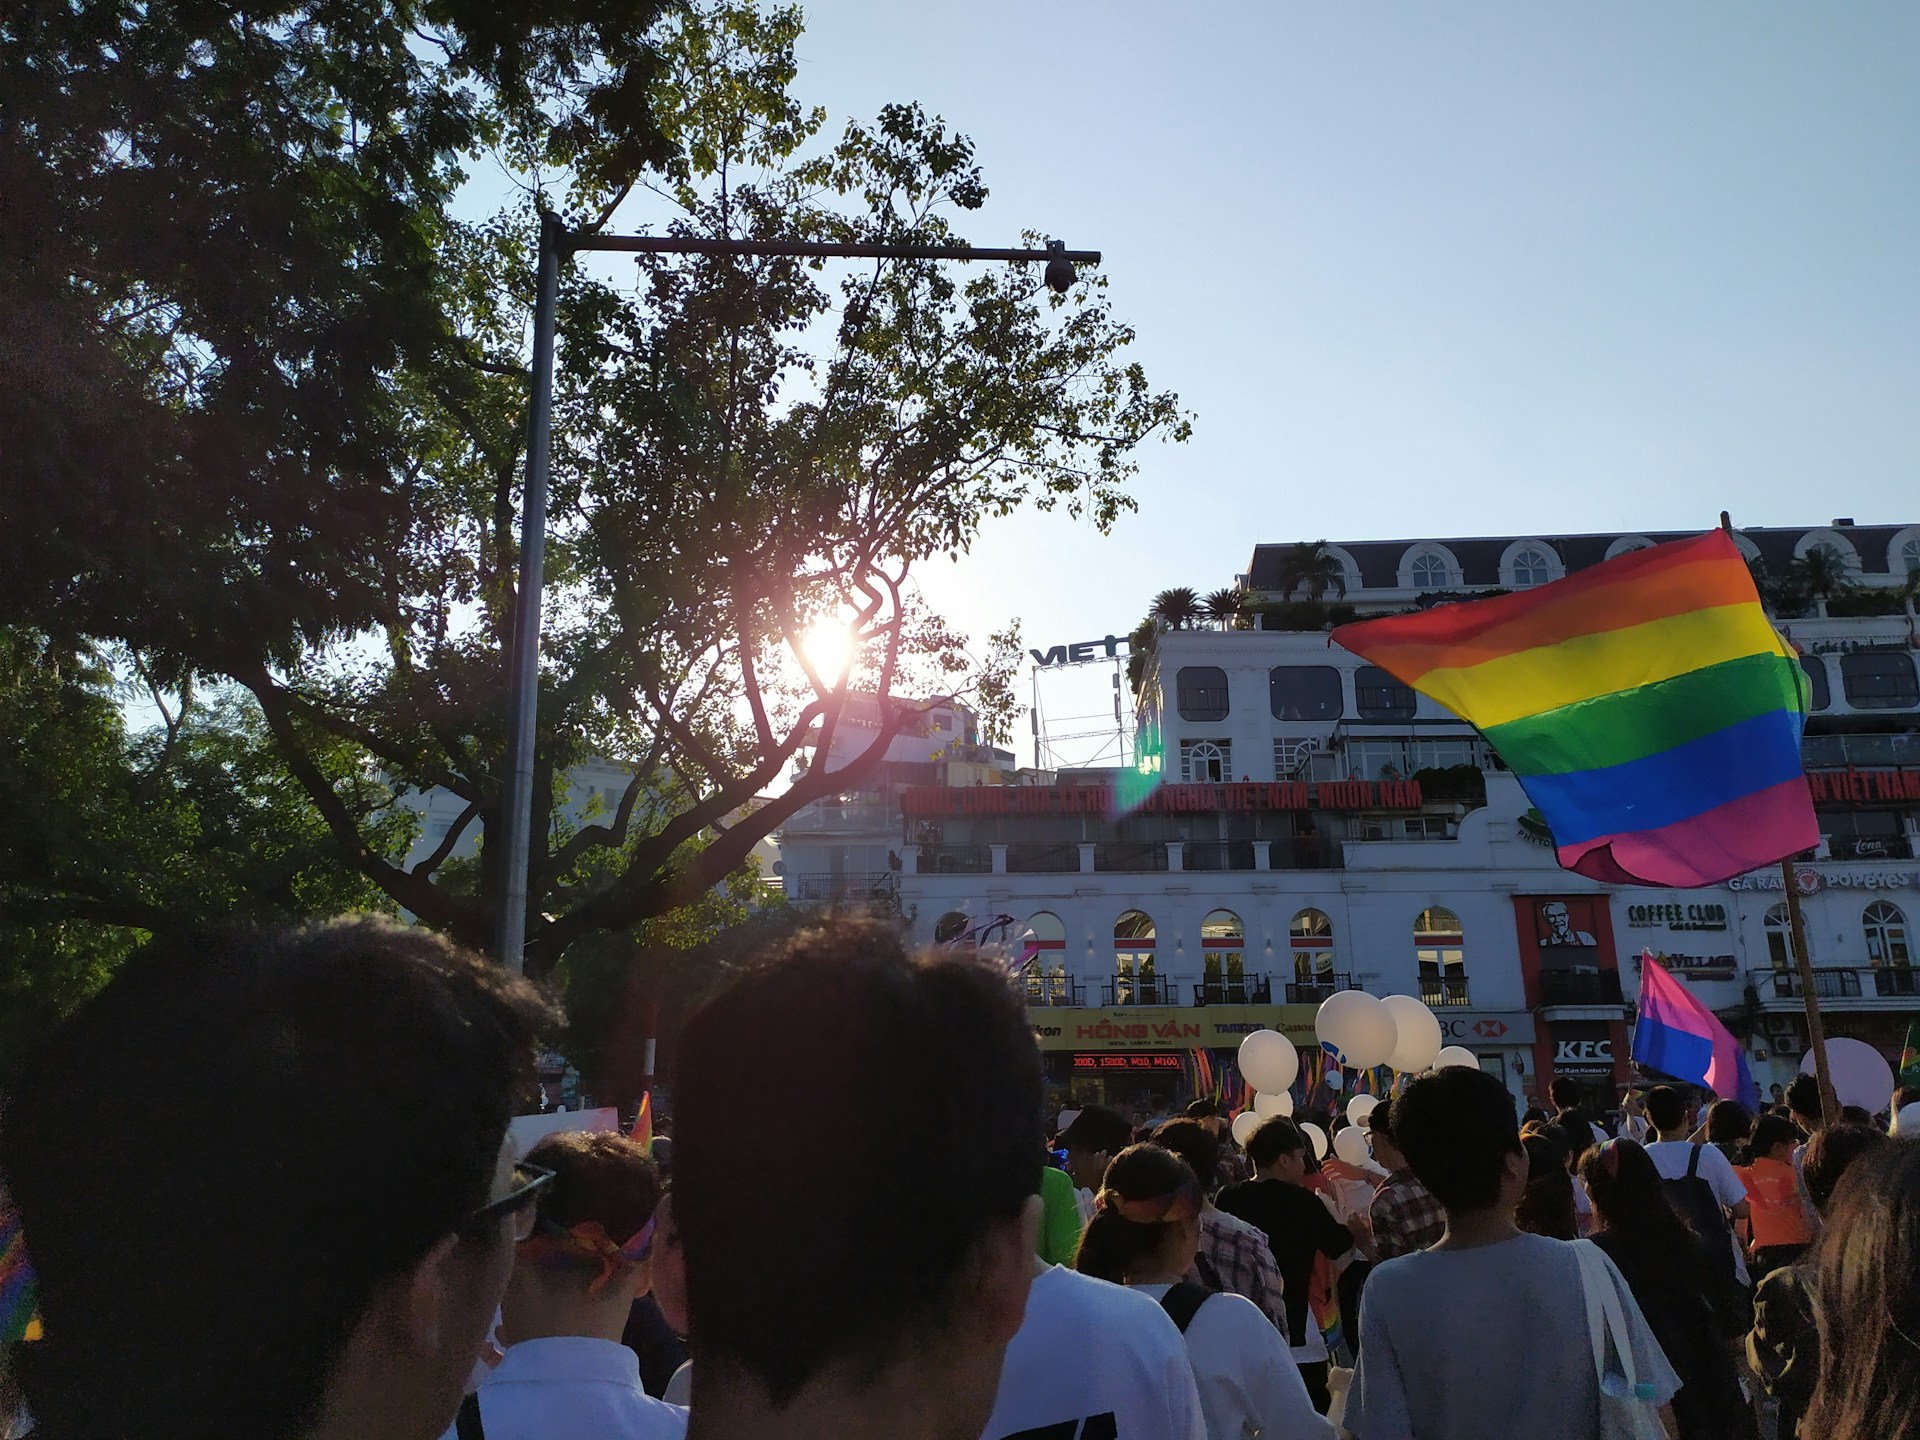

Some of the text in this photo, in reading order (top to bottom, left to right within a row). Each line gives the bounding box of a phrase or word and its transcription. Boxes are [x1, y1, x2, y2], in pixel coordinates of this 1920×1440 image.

[1876, 771, 1920, 800] NAM
[1267, 782, 1308, 810] NAM
[1628, 904, 1726, 921] COFFEE CLUB
[1151, 1019, 1201, 1039] VÂN
[1440, 1020, 1466, 1038] BC
[1556, 1039, 1612, 1058] KFC
